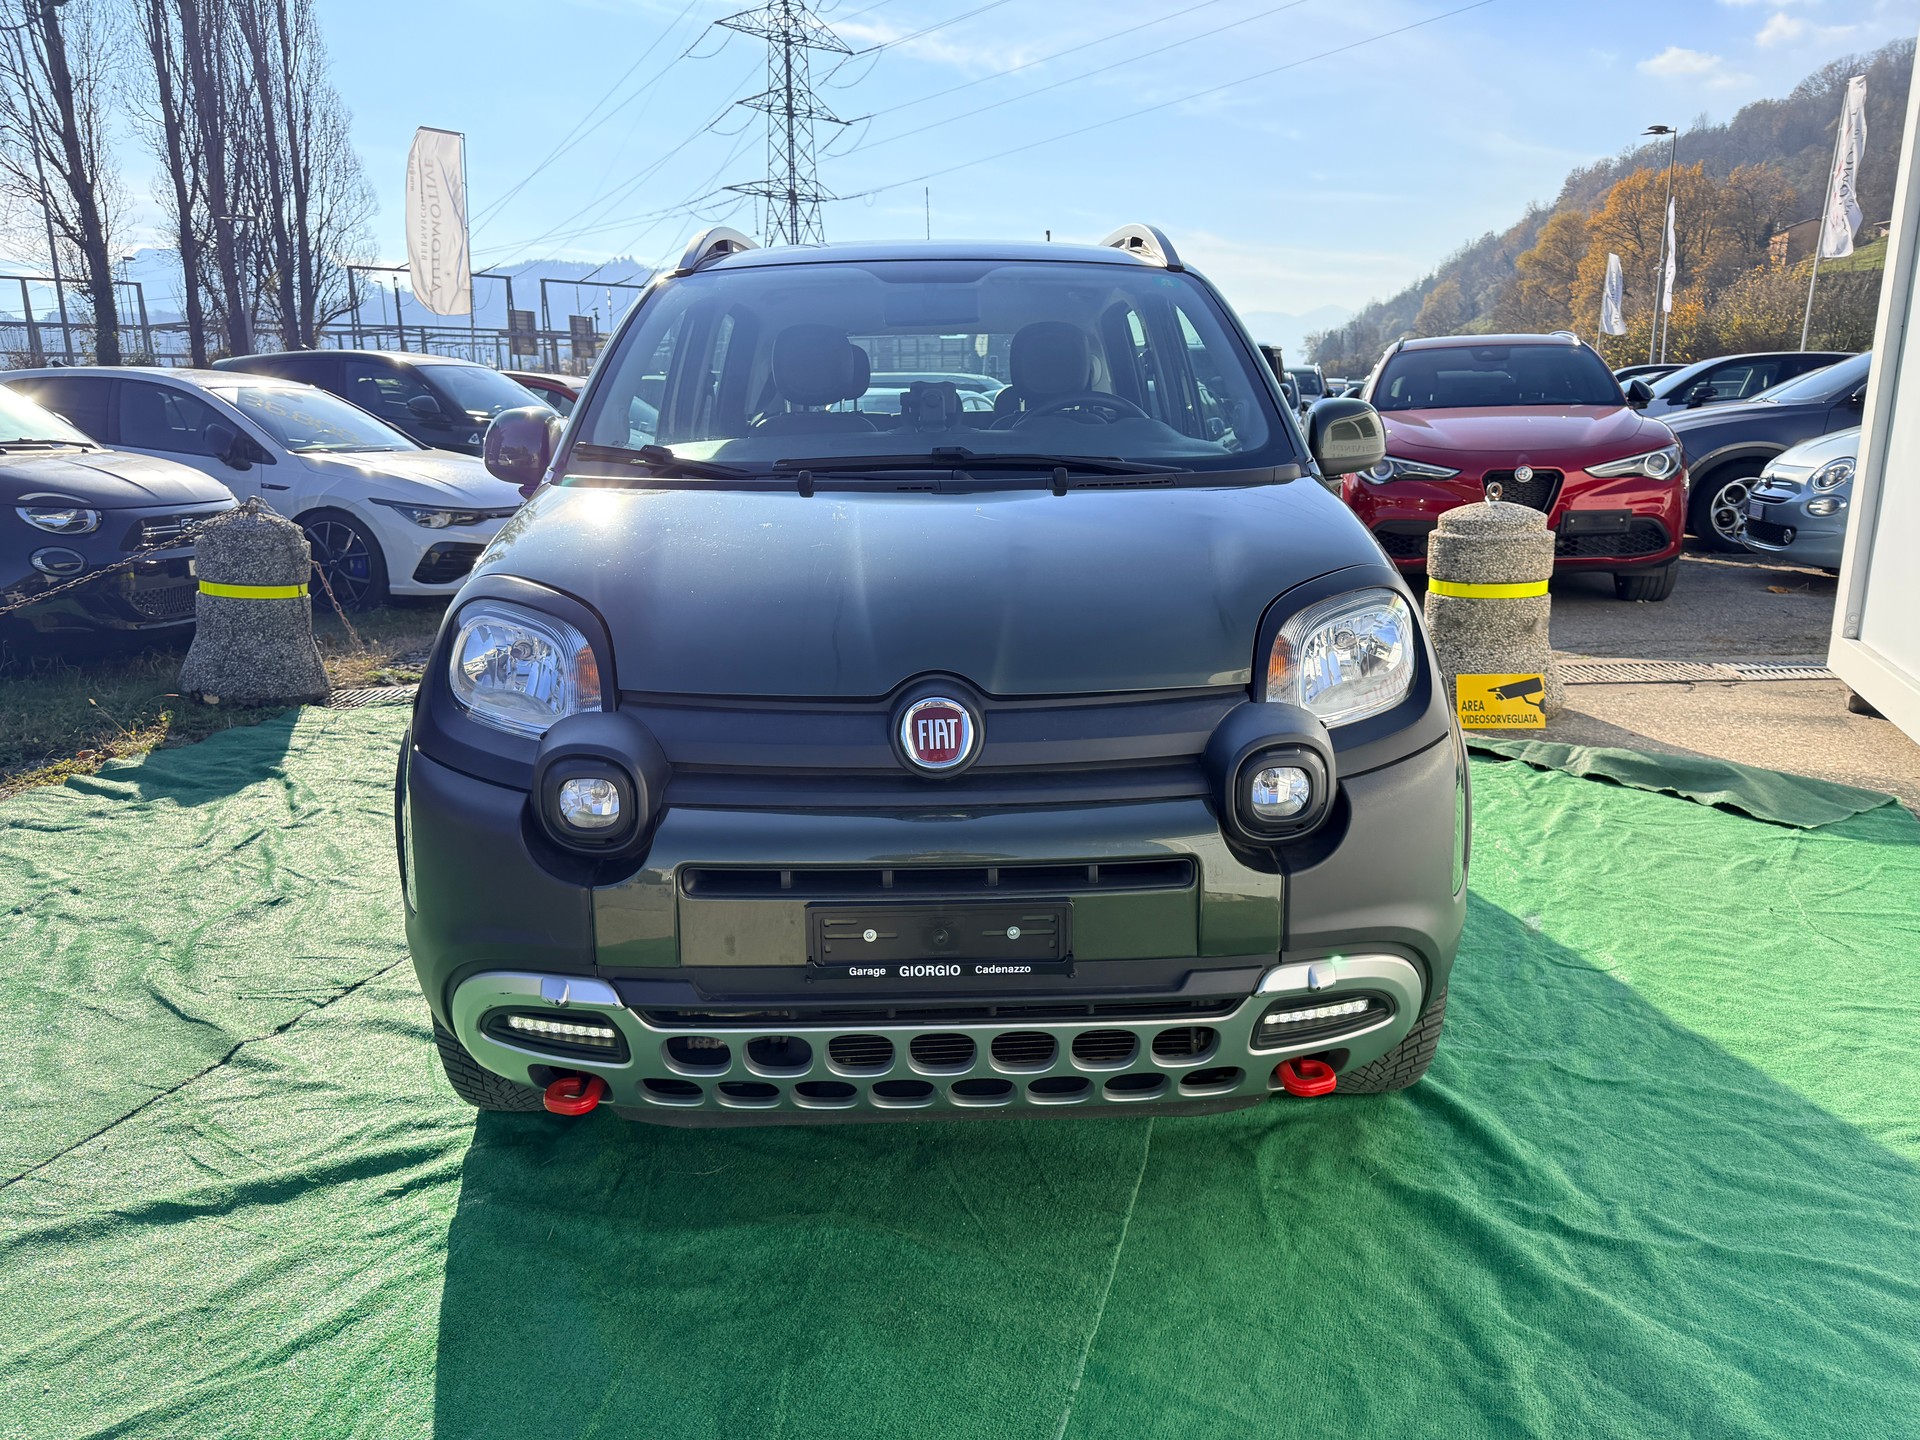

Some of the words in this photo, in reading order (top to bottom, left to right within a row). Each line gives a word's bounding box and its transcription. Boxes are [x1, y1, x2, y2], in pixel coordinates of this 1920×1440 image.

[1461, 700, 1485, 711] AREA
[1461, 714, 1538, 724] VIDEOSORVEGLIATA
[917, 718, 958, 750] FIAT
[849, 967, 886, 977] Garage
[899, 965, 961, 977] GIORGIO
[975, 965, 1031, 974] Cadenazzo
